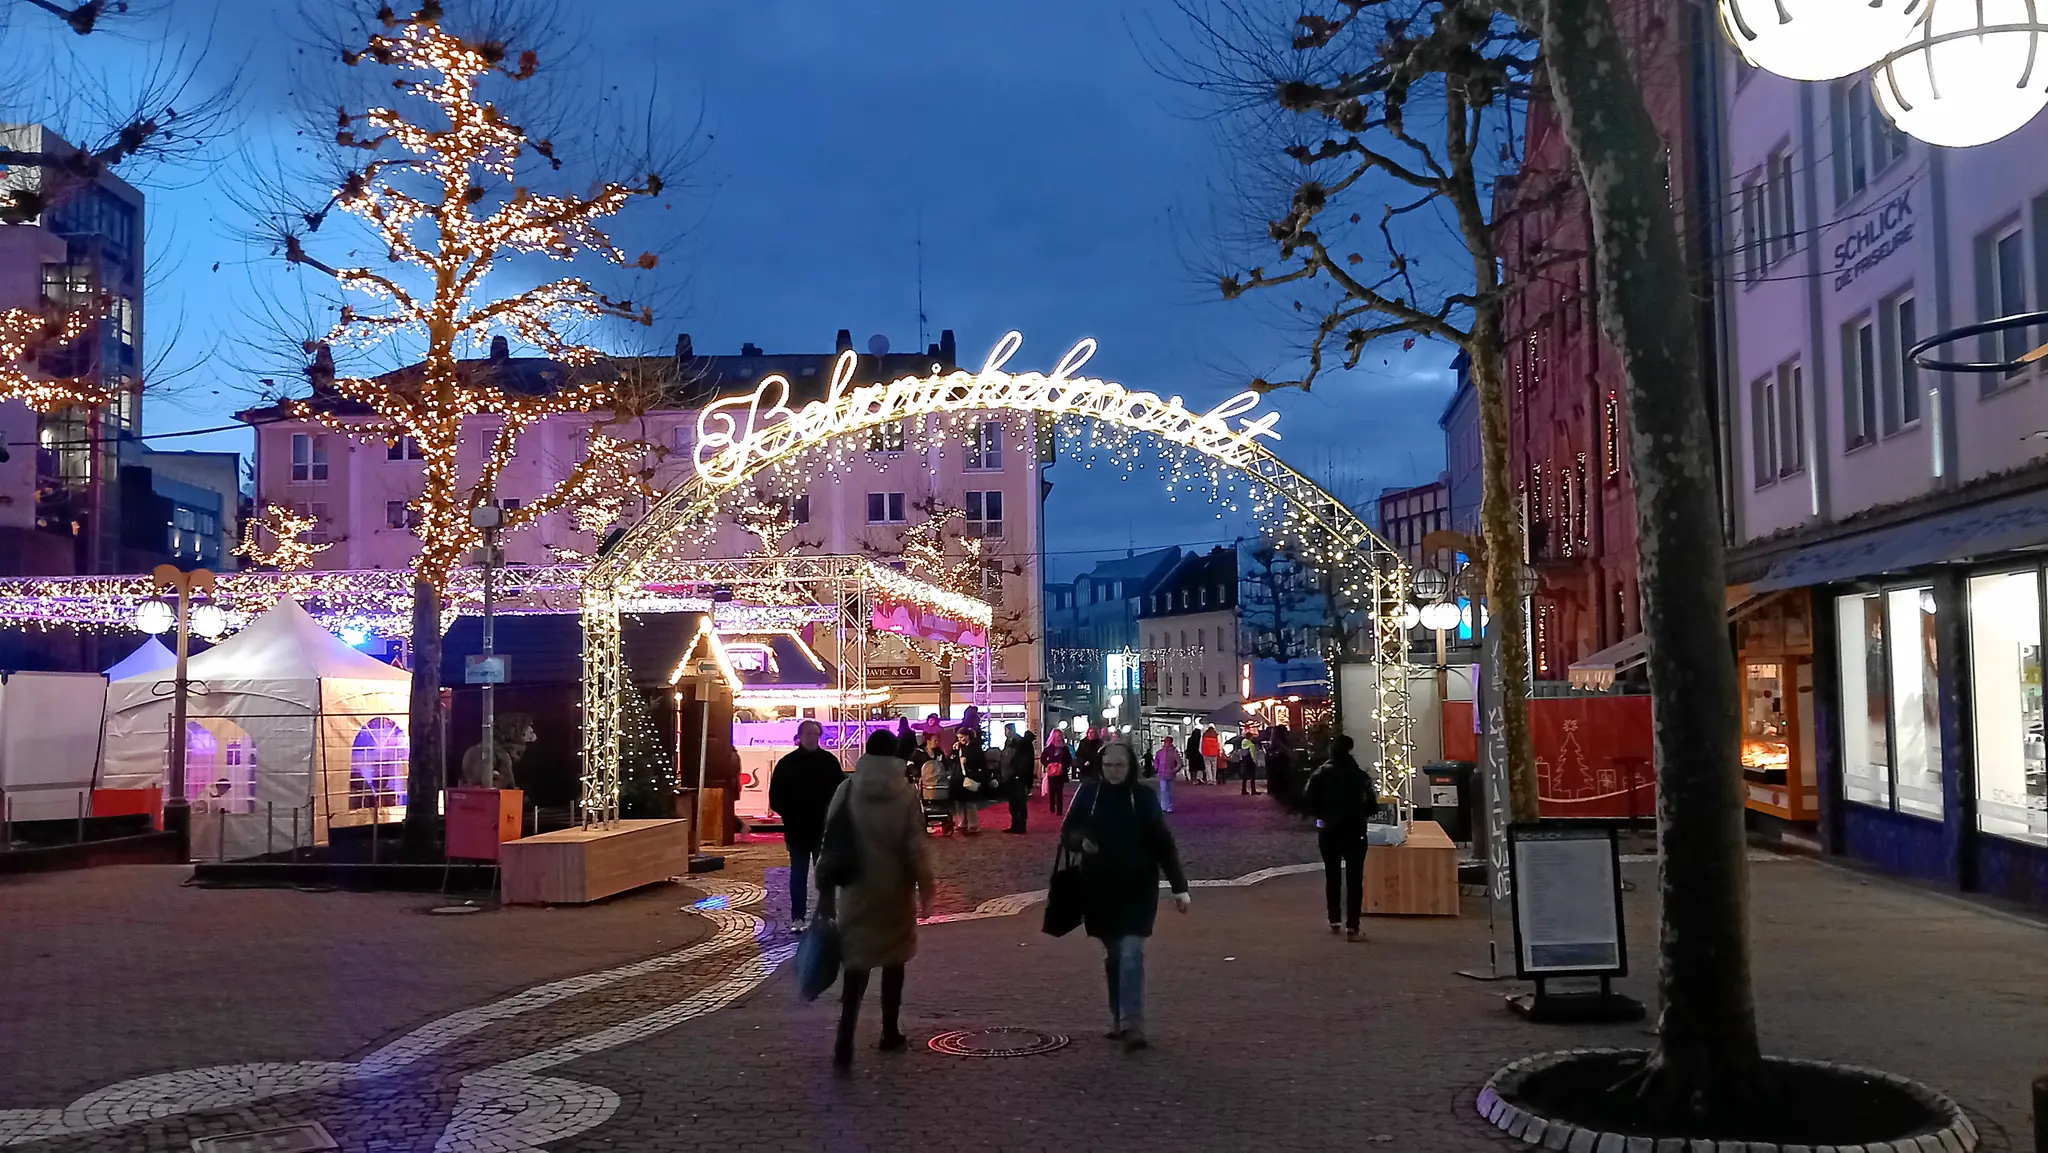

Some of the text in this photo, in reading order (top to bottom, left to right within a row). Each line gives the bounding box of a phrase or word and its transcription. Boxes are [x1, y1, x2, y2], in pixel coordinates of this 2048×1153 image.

[1834, 188, 1912, 269] SCHLICK
[1834, 223, 1914, 292] DIE FRISEURE
